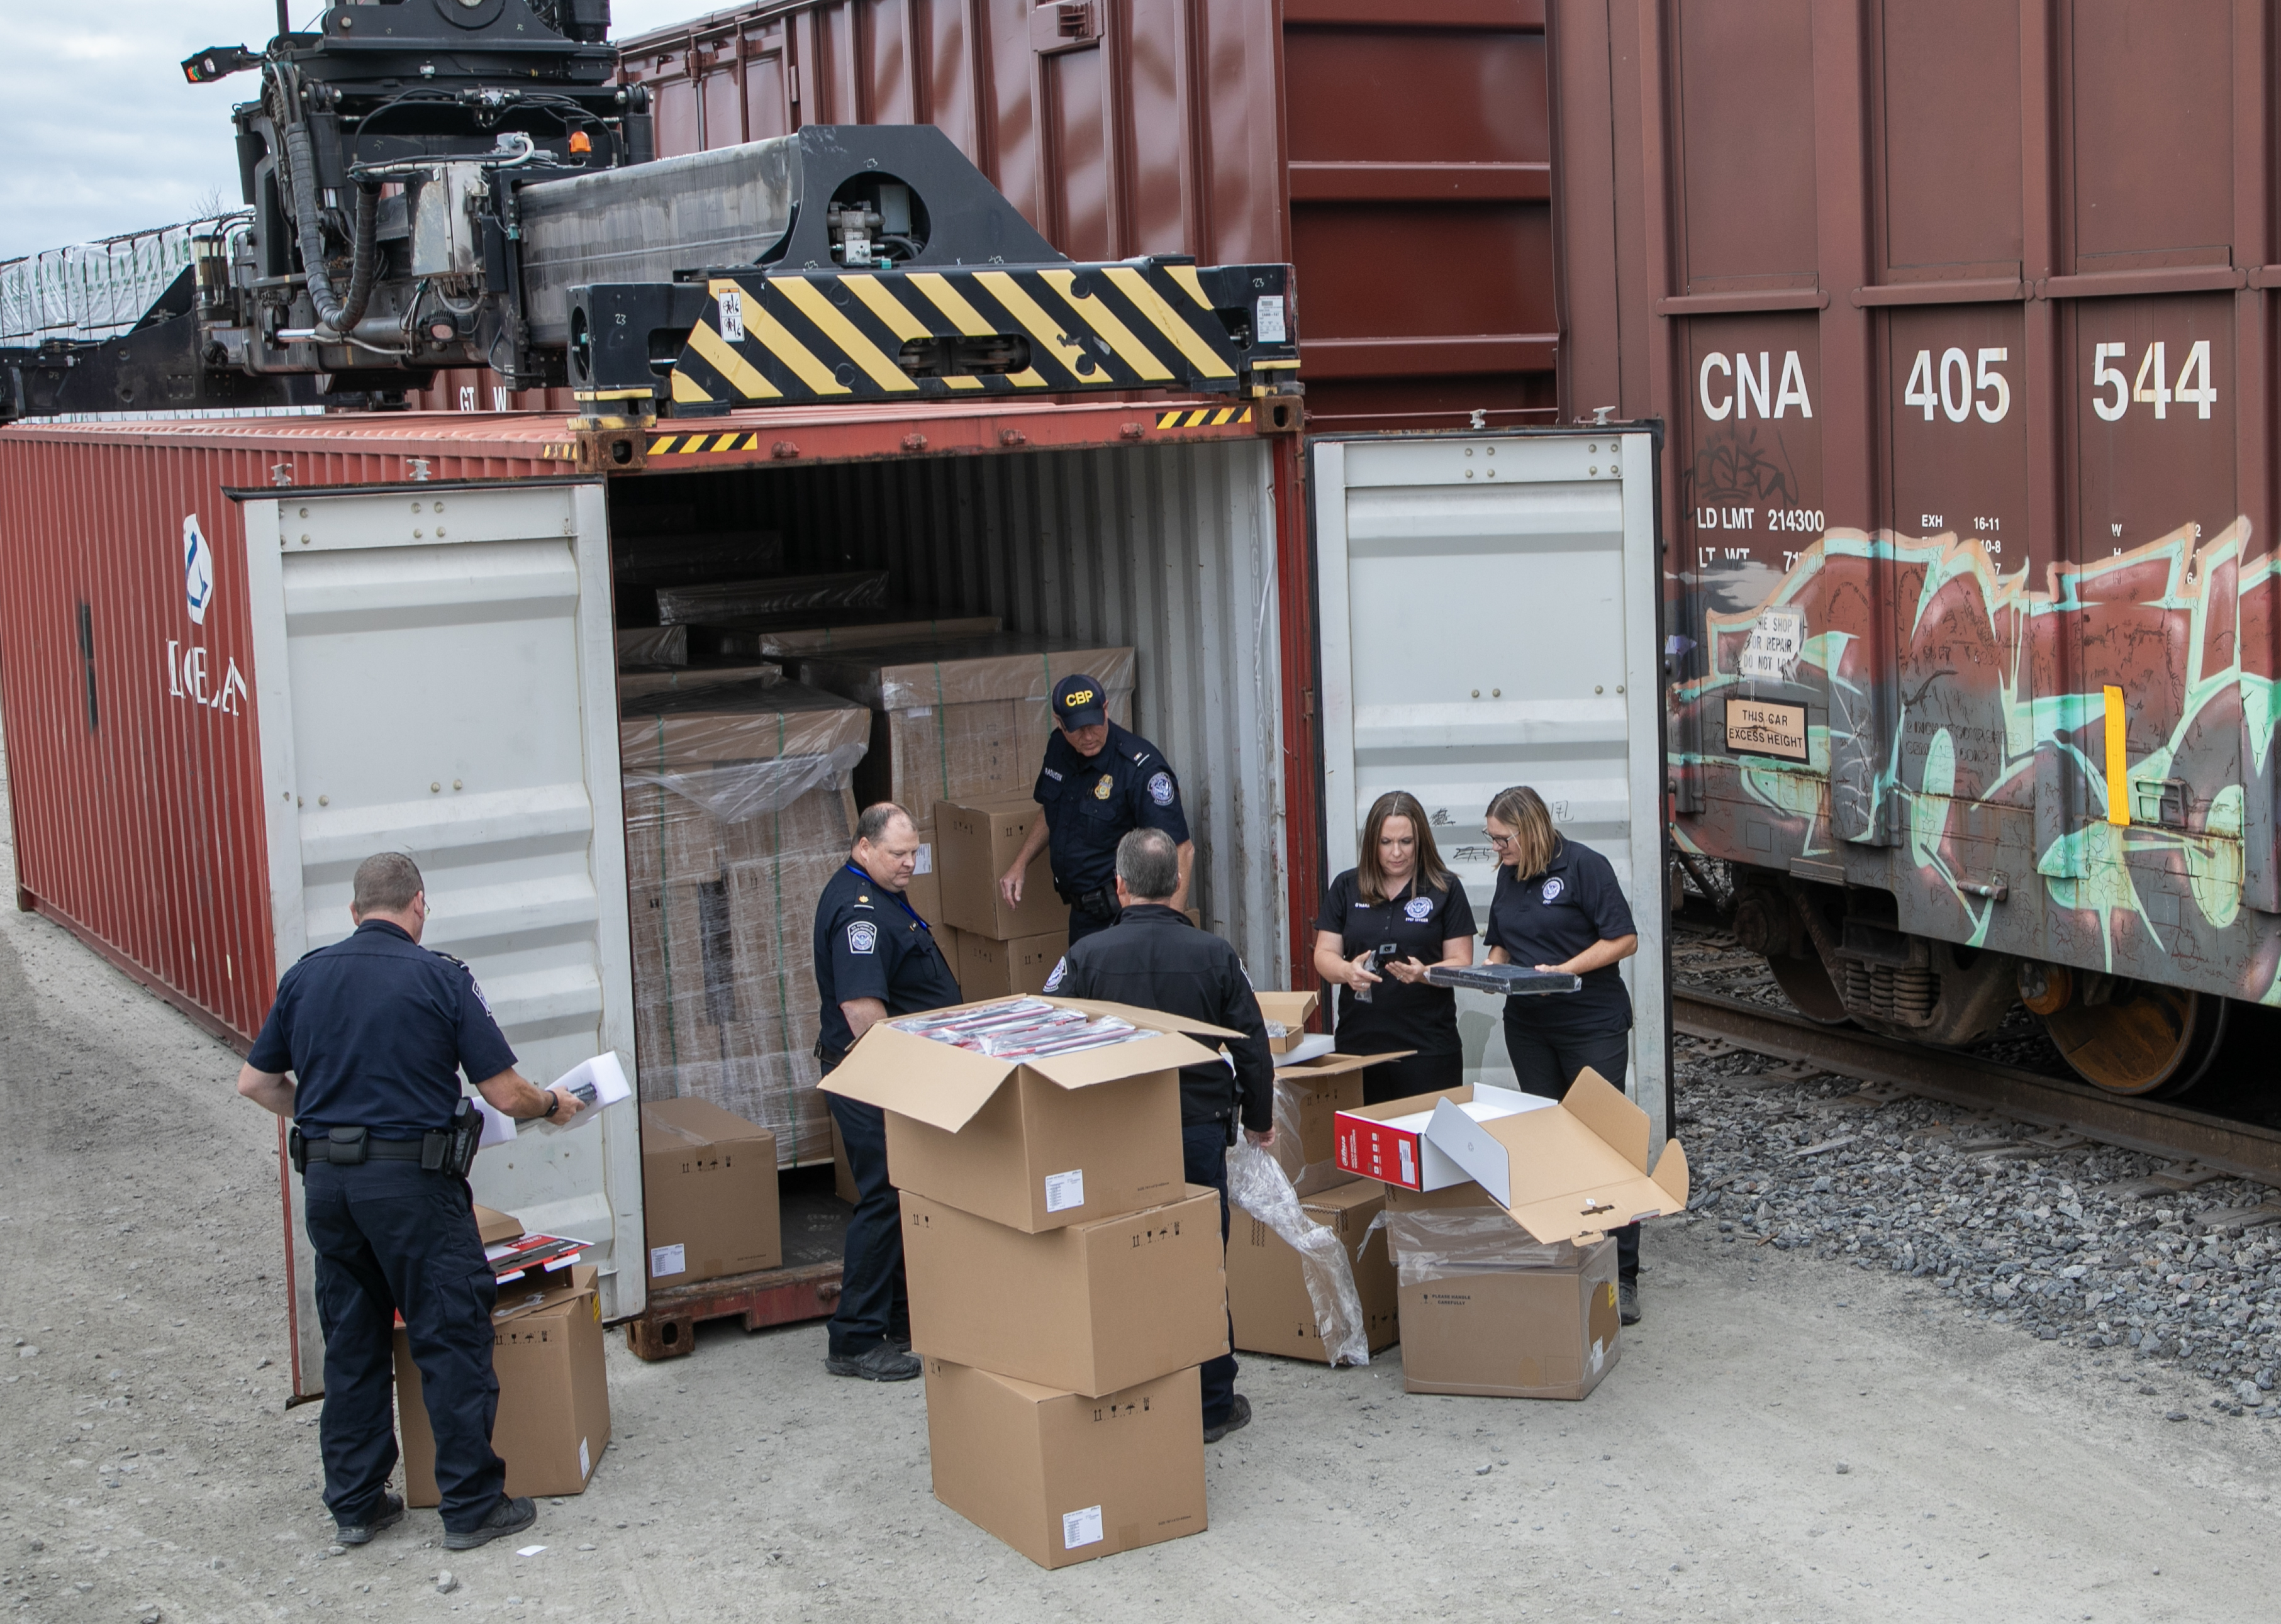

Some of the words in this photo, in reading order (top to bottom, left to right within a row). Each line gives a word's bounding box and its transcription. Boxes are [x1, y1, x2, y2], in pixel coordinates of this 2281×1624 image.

[615, 314, 626, 325] 23
[1700, 350, 1813, 421] CNA
[1904, 347, 2011, 423] 405
[2092, 340, 2217, 423] 544
[460, 386, 474, 411] GT
[1697, 508, 1717, 528] LD
[1722, 508, 1754, 529] LMT
[1768, 509, 1824, 532] 214300
[1922, 514, 1943, 527] EXH
[1974, 517, 1999, 530] 16-11
[2111, 523, 2122, 537] W
[1699, 547, 1716, 568] LT
[1725, 547, 1750, 570] WT
[2113, 547, 2121, 560] H
[1773, 617, 1792, 633] SHOP
[1767, 637, 1792, 653] REPAIR
[1744, 655, 1753, 668] DO
[1758, 655, 1773, 671] NOT
[1066, 690, 1093, 707] CBP
[1743, 709, 1763, 723] THIS
[1768, 713, 1788, 726] CAR
[1729, 728, 1765, 743] EXCESS
[1767, 733, 1803, 748] HEIGHT
